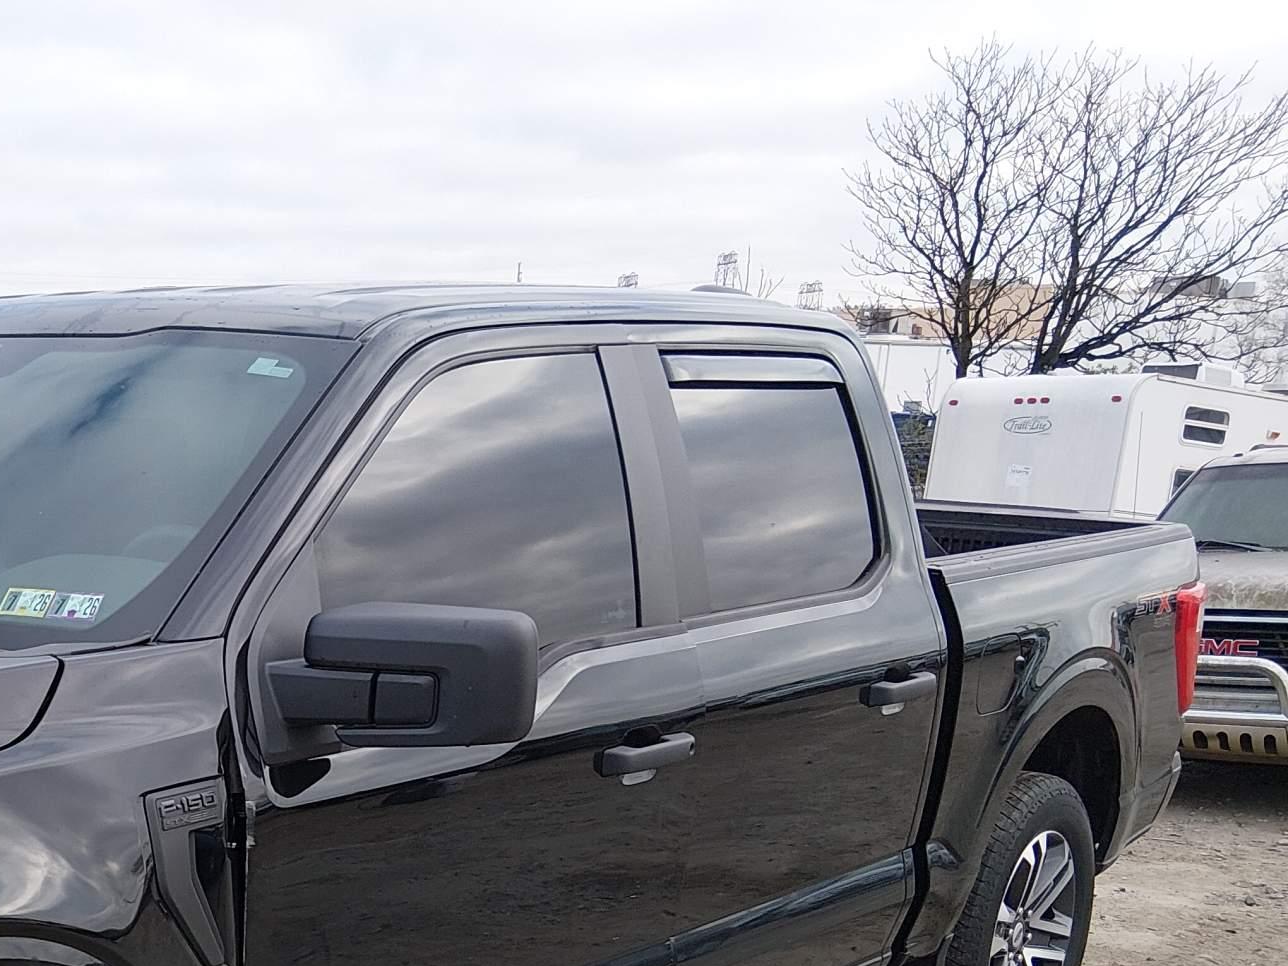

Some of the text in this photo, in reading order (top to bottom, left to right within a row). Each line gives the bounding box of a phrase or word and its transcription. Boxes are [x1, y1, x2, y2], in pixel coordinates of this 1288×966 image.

[33, 594, 52, 611] 26
[83, 598, 101, 615] 26
[159, 791, 217, 818] F-150
